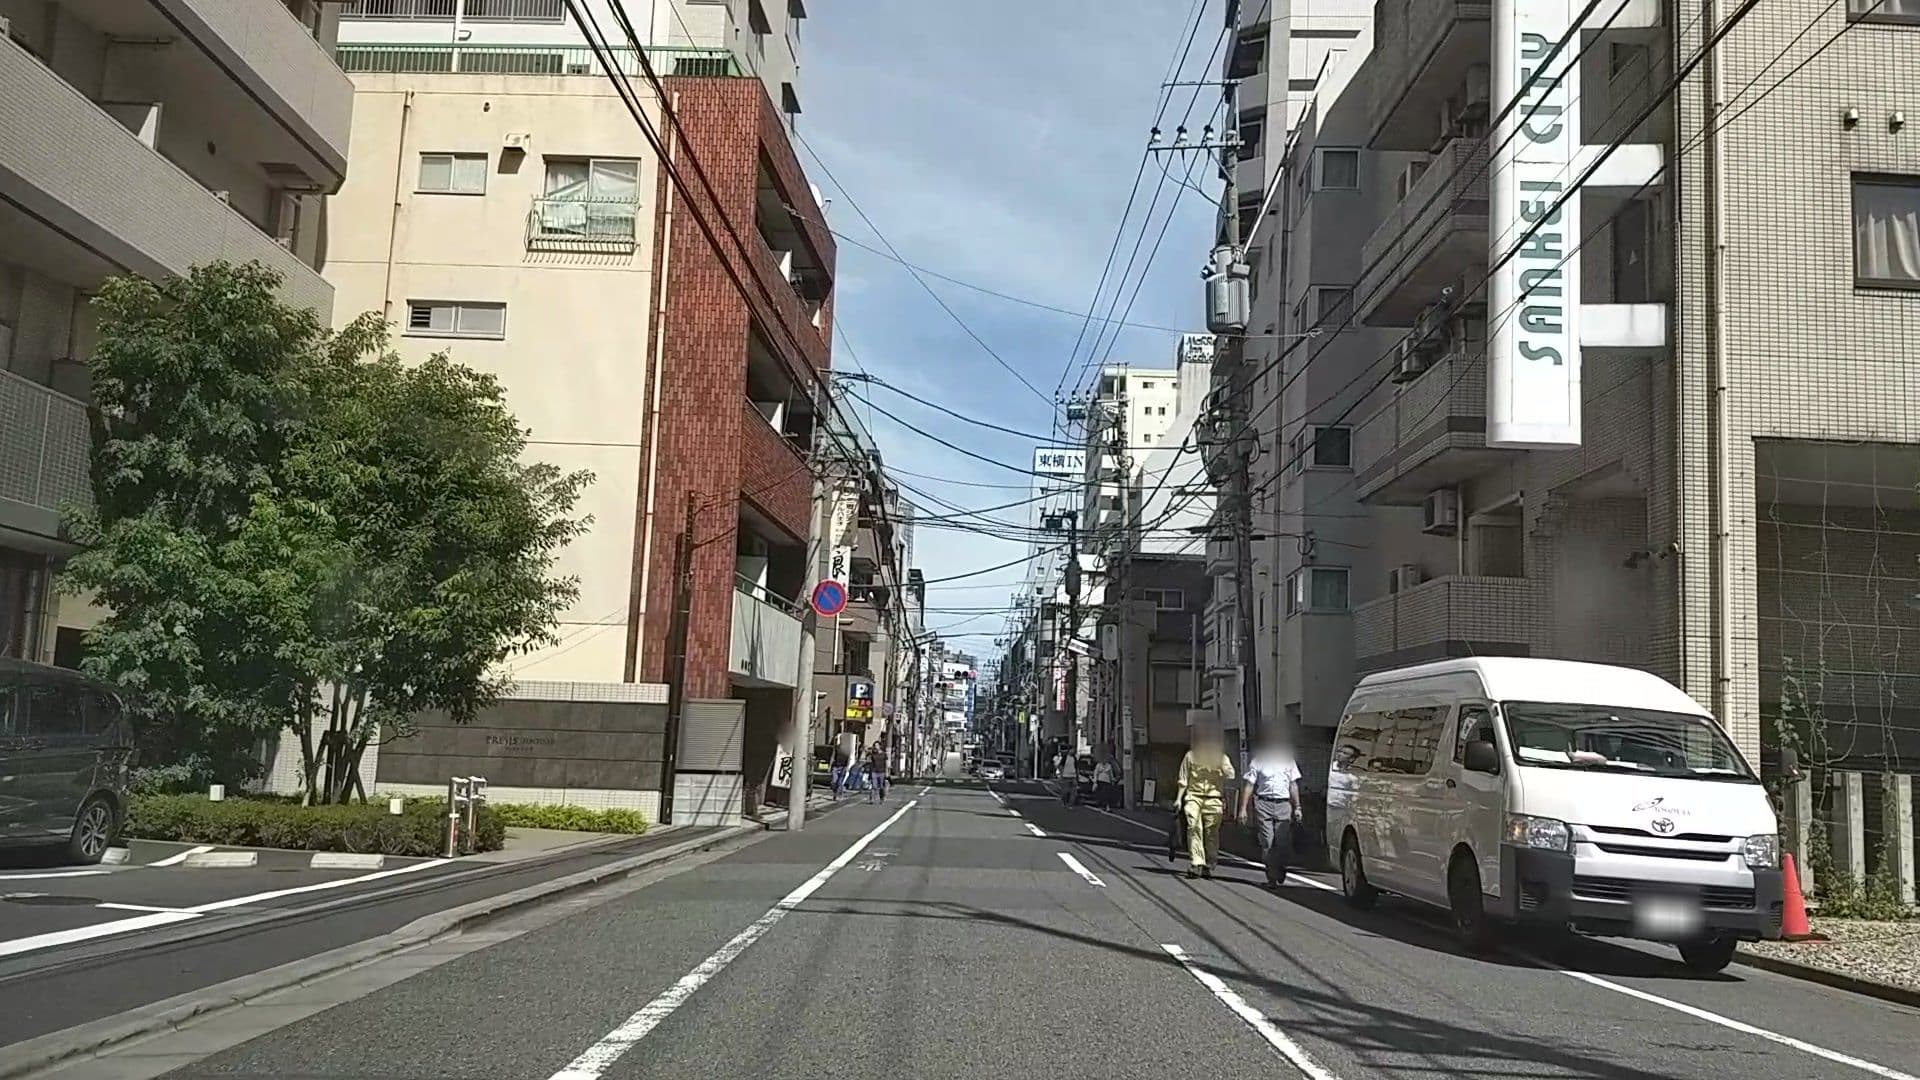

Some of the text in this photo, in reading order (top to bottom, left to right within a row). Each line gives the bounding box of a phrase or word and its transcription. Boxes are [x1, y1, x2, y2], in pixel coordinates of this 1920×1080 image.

[1518, 31, 1564, 366] SANKEI CITY
[855, 683, 869, 698] P
